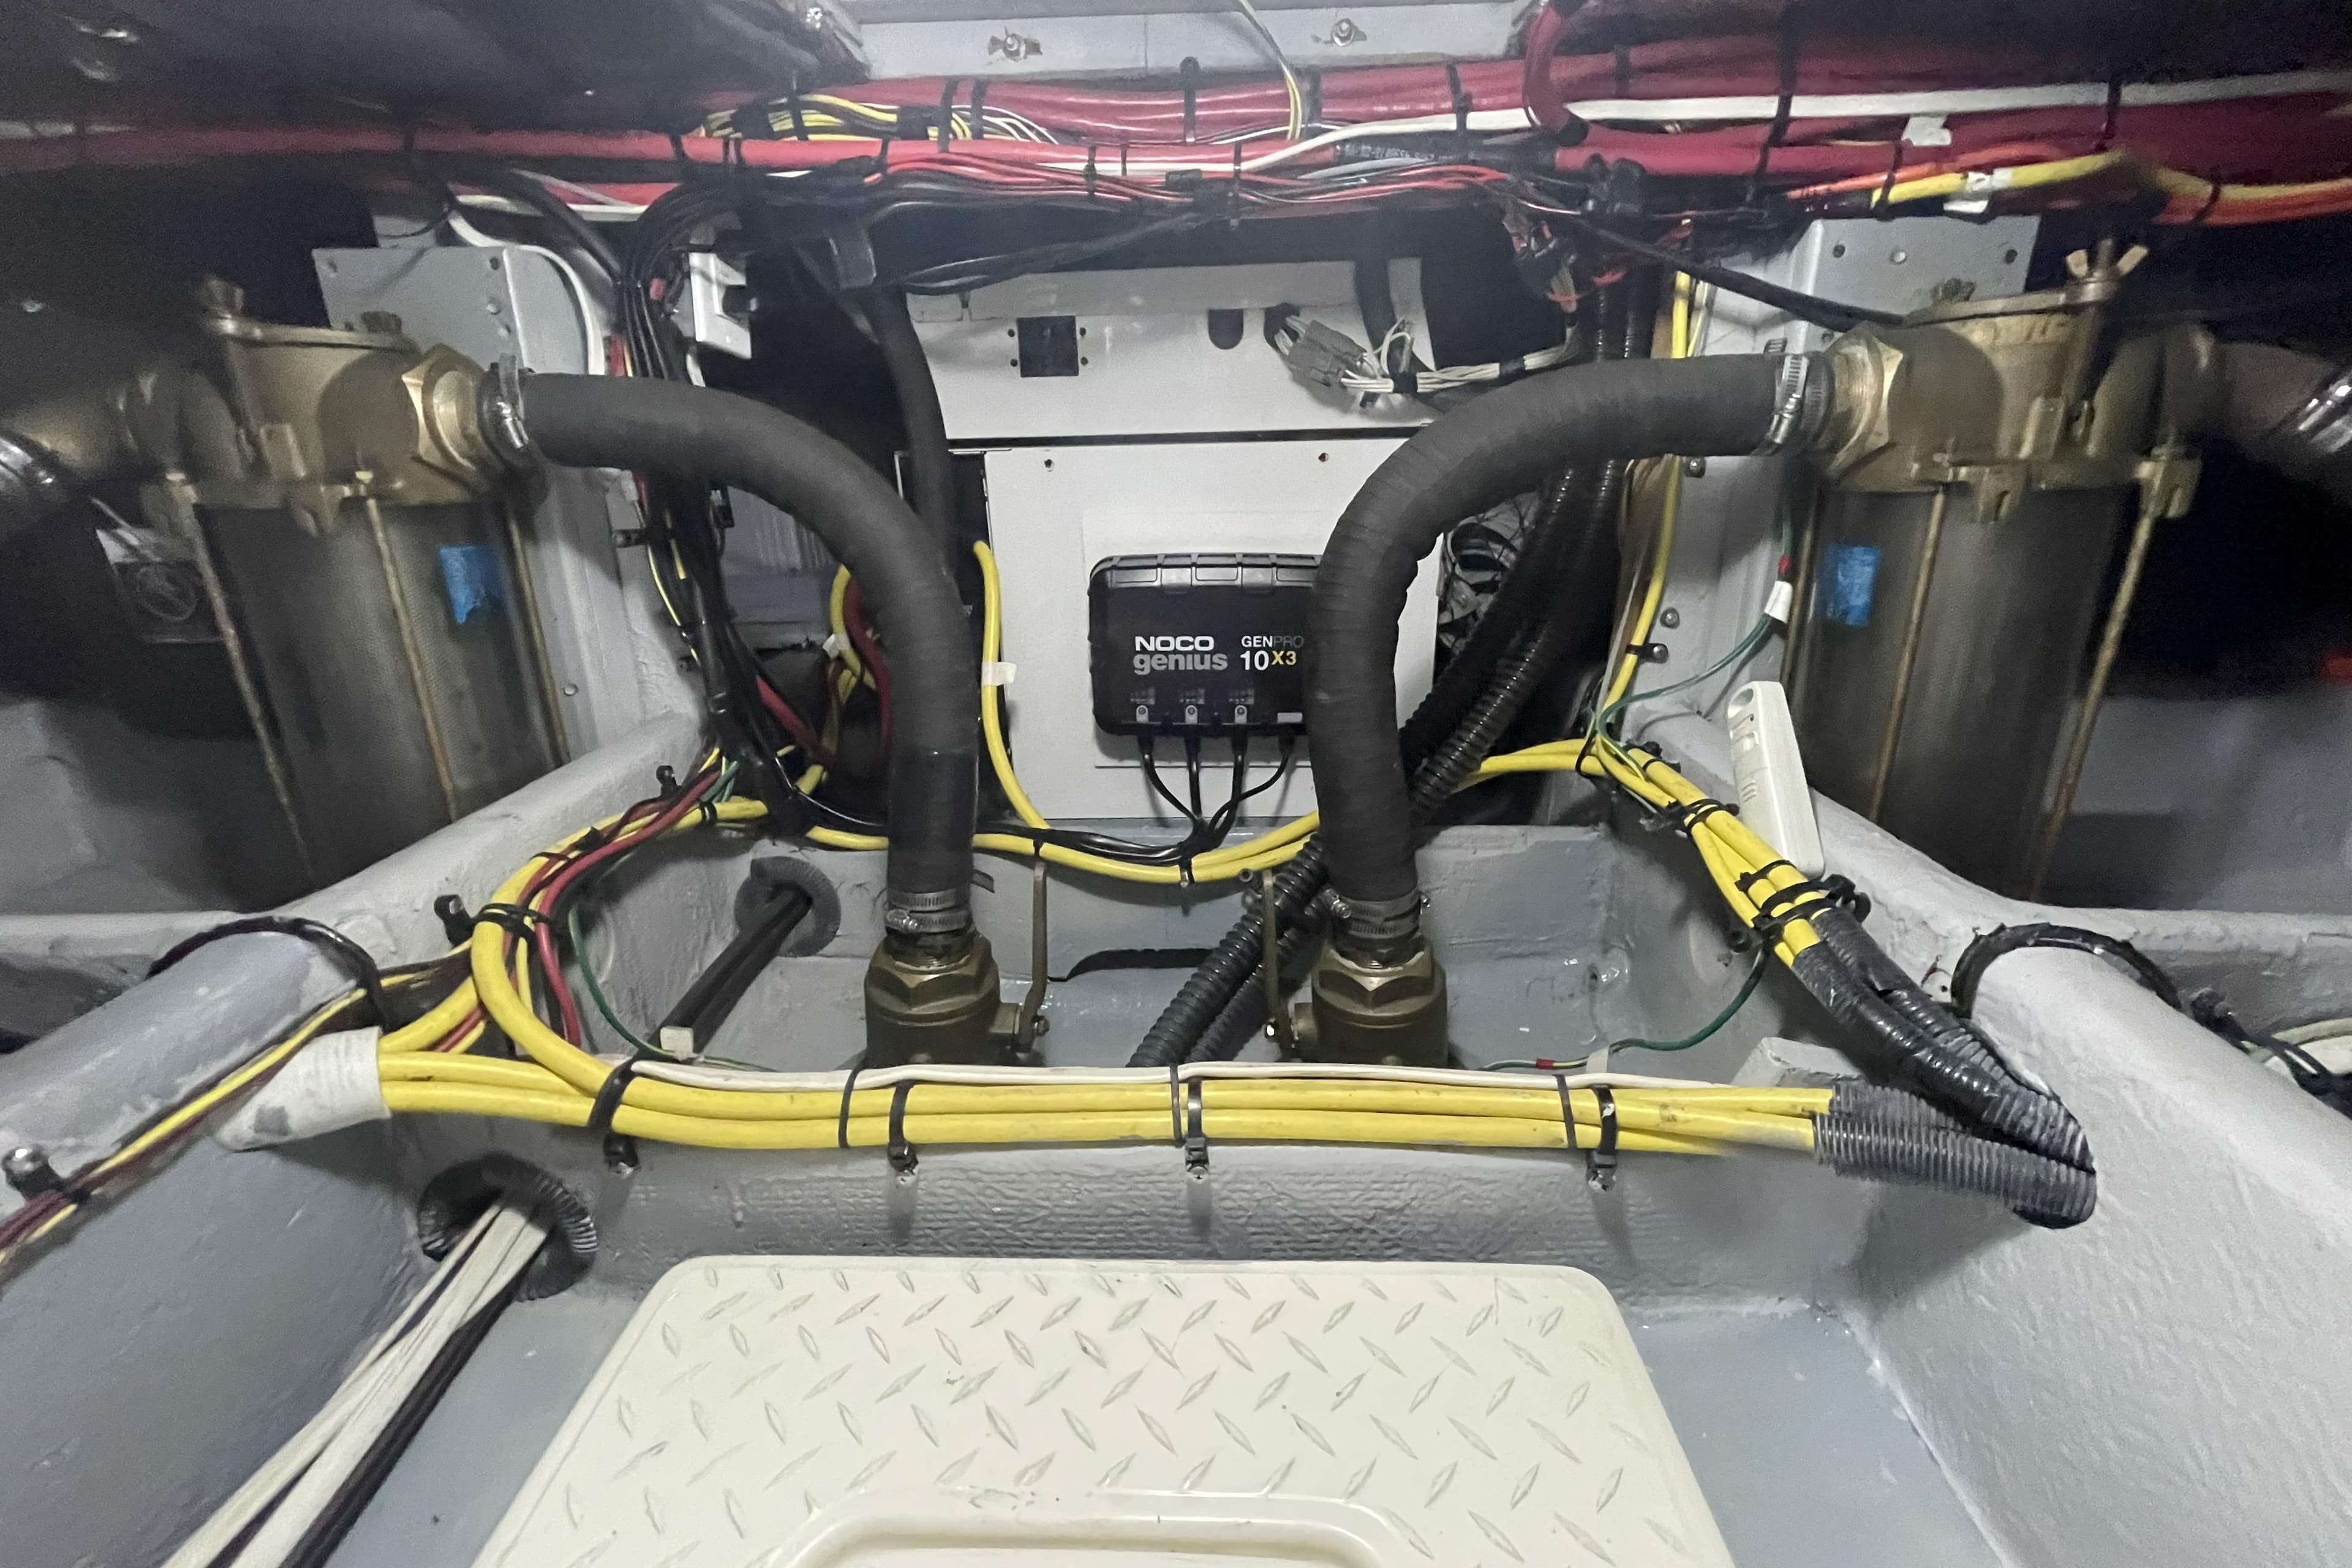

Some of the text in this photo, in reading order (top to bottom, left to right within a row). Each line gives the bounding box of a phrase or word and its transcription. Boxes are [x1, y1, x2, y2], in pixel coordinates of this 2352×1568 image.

[1135, 636, 1215, 651] NOCO
[1241, 635, 1304, 648] GENPRO
[1133, 653, 1229, 675] genius
